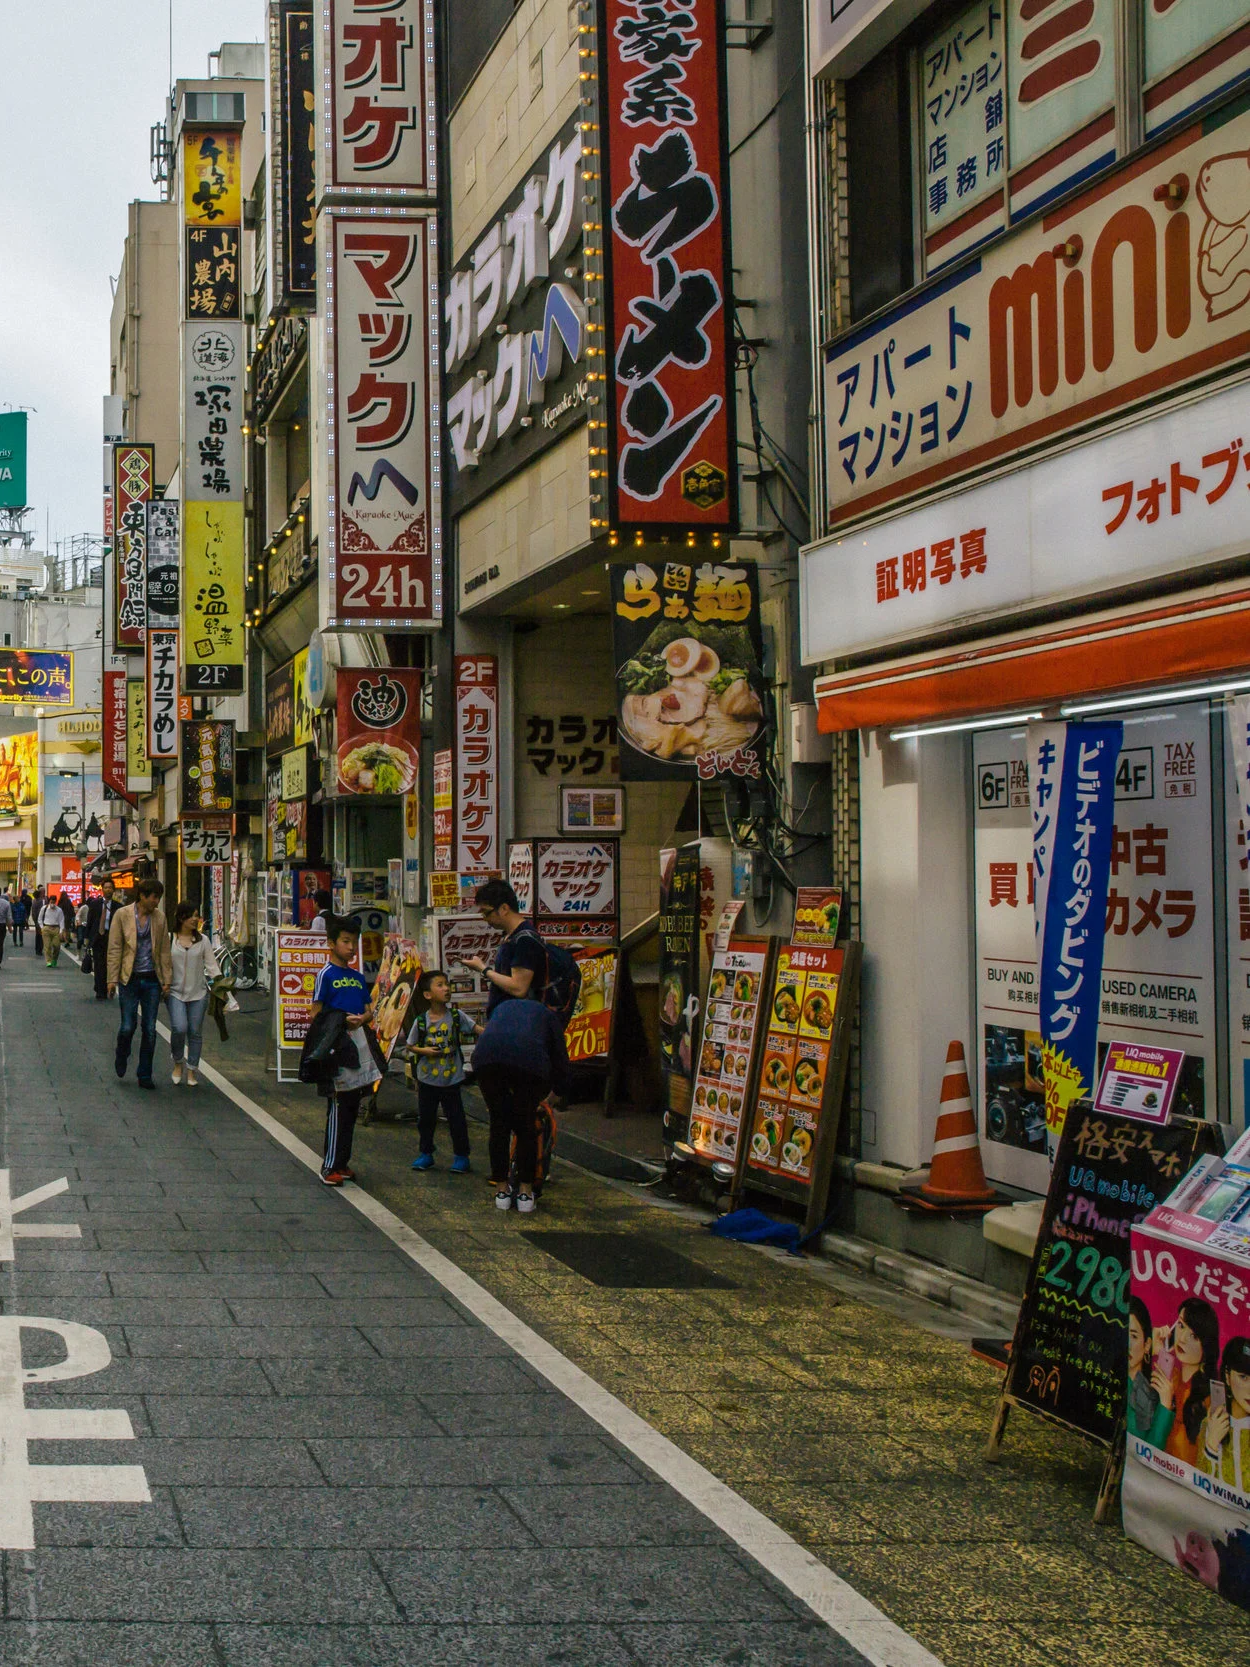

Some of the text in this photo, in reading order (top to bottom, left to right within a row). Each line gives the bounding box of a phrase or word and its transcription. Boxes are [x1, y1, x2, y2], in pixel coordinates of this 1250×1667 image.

[926, 6, 1001, 89] アパート
[343, 0, 418, 172] オケ
[927, 50, 1002, 127] マンション
[190, 229, 207, 243] 4F
[445, 132, 582, 373] カラオケ
[344, 233, 419, 450] マック
[836, 304, 972, 428] アパート
[447, 332, 523, 472] マック
[837, 379, 973, 485] マンション
[1101, 437, 1250, 536] フォトブ
[354, 508, 392, 521] Karaoke
[876, 527, 988, 605] 証明写真
[341, 563, 427, 609] 24h
[198, 665, 229, 685] 2F
[458, 661, 495, 682] 2F
[152, 646, 176, 754] チカラめし
[1165, 742, 1196, 760] TAX
[1010, 759, 1029, 776] TA
[1010, 774, 1029, 790] FRE
[1114, 758, 1148, 793] 4F
[1164, 760, 1196, 777] FREE
[981, 771, 1006, 802] 6F
[541, 859, 610, 879] カラオケ
[552, 880, 601, 898] マック
[1049, 739, 1105, 1042] ビデオのダビング
[562, 900, 591, 913] 24H
[1105, 888, 1197, 940] カメラ
[987, 967, 1035, 985] BUY AND
[1102, 978, 1198, 1003] USED CAMERA
[1139, 1051, 1165, 1062] mobile
[1153, 1453, 1186, 1479] mobile
